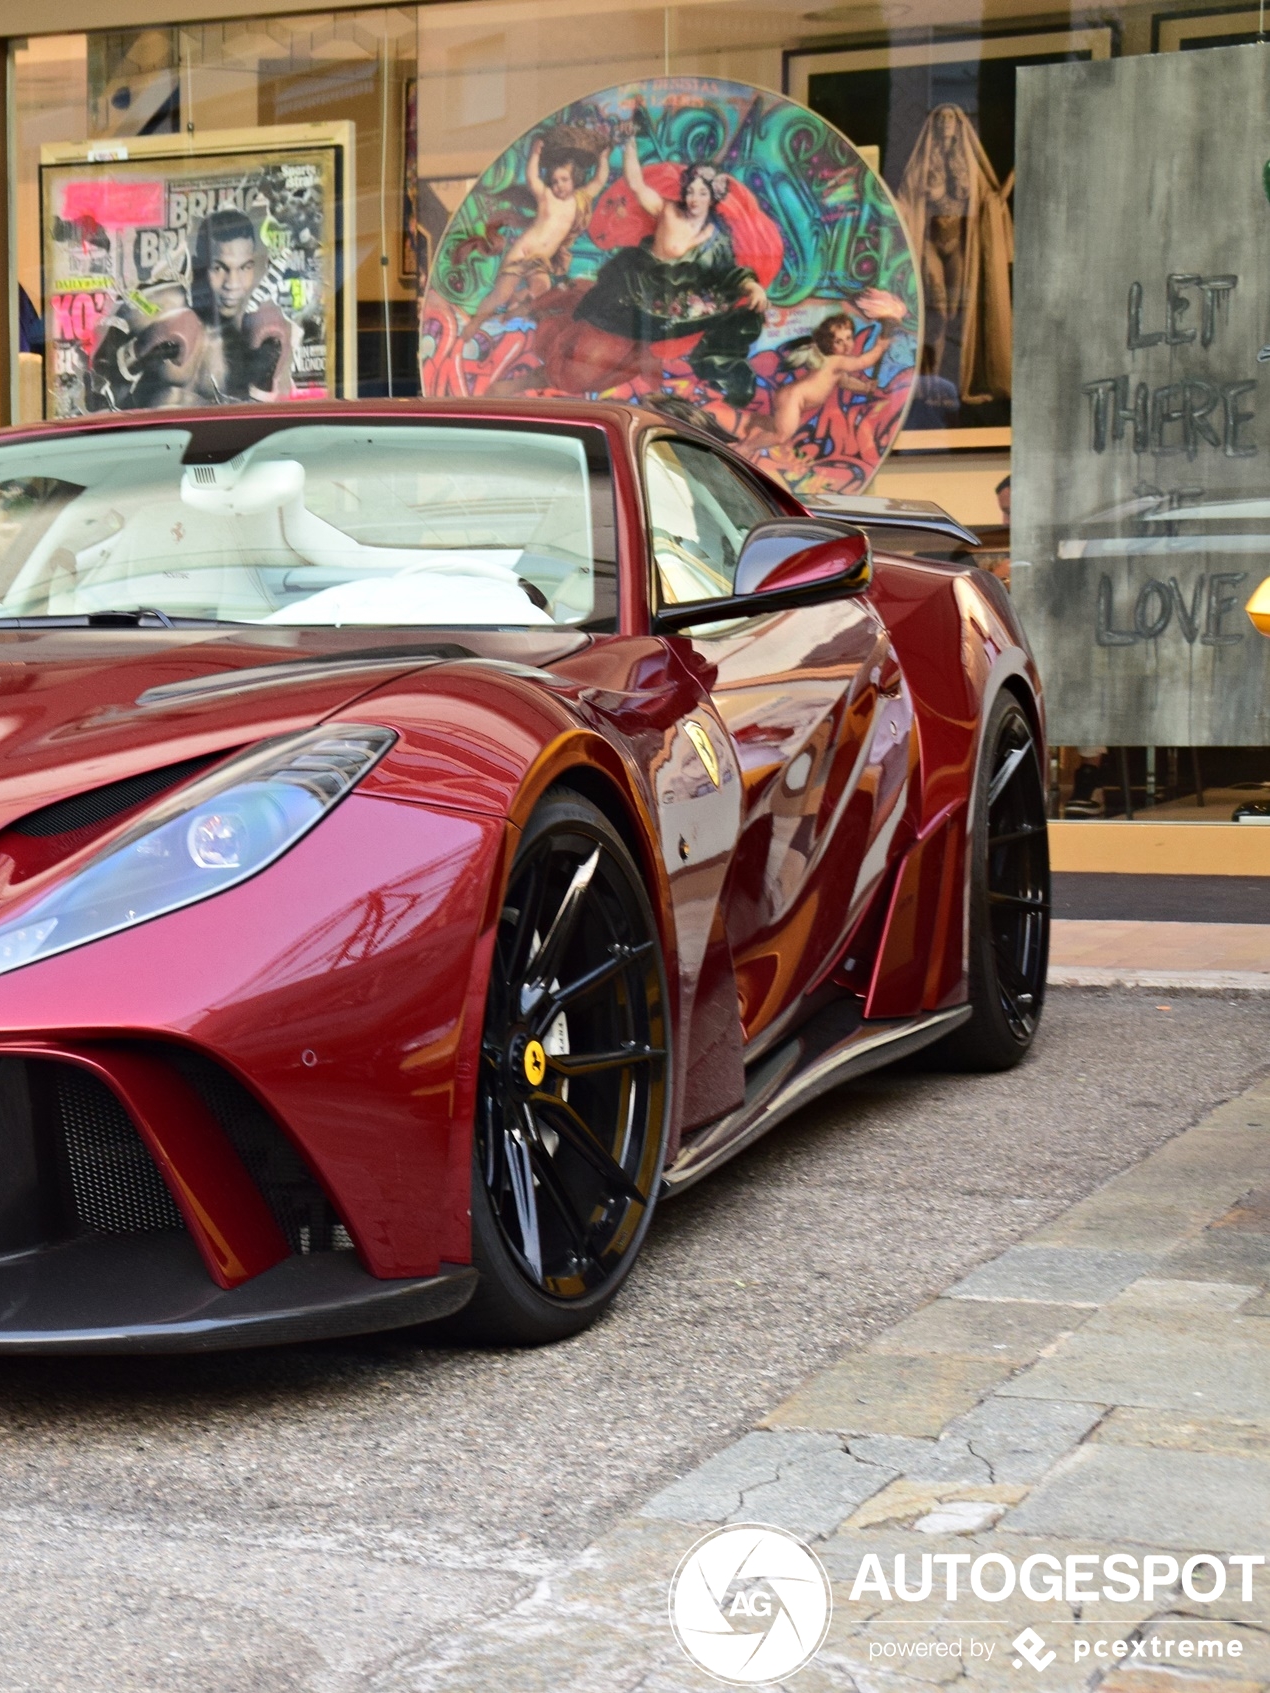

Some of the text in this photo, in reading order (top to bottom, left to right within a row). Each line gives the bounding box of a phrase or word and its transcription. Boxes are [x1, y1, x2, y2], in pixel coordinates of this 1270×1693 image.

[1127, 273, 1238, 349] LET
[1081, 376, 1258, 460] THERE
[1095, 572, 1248, 646] LOVE
